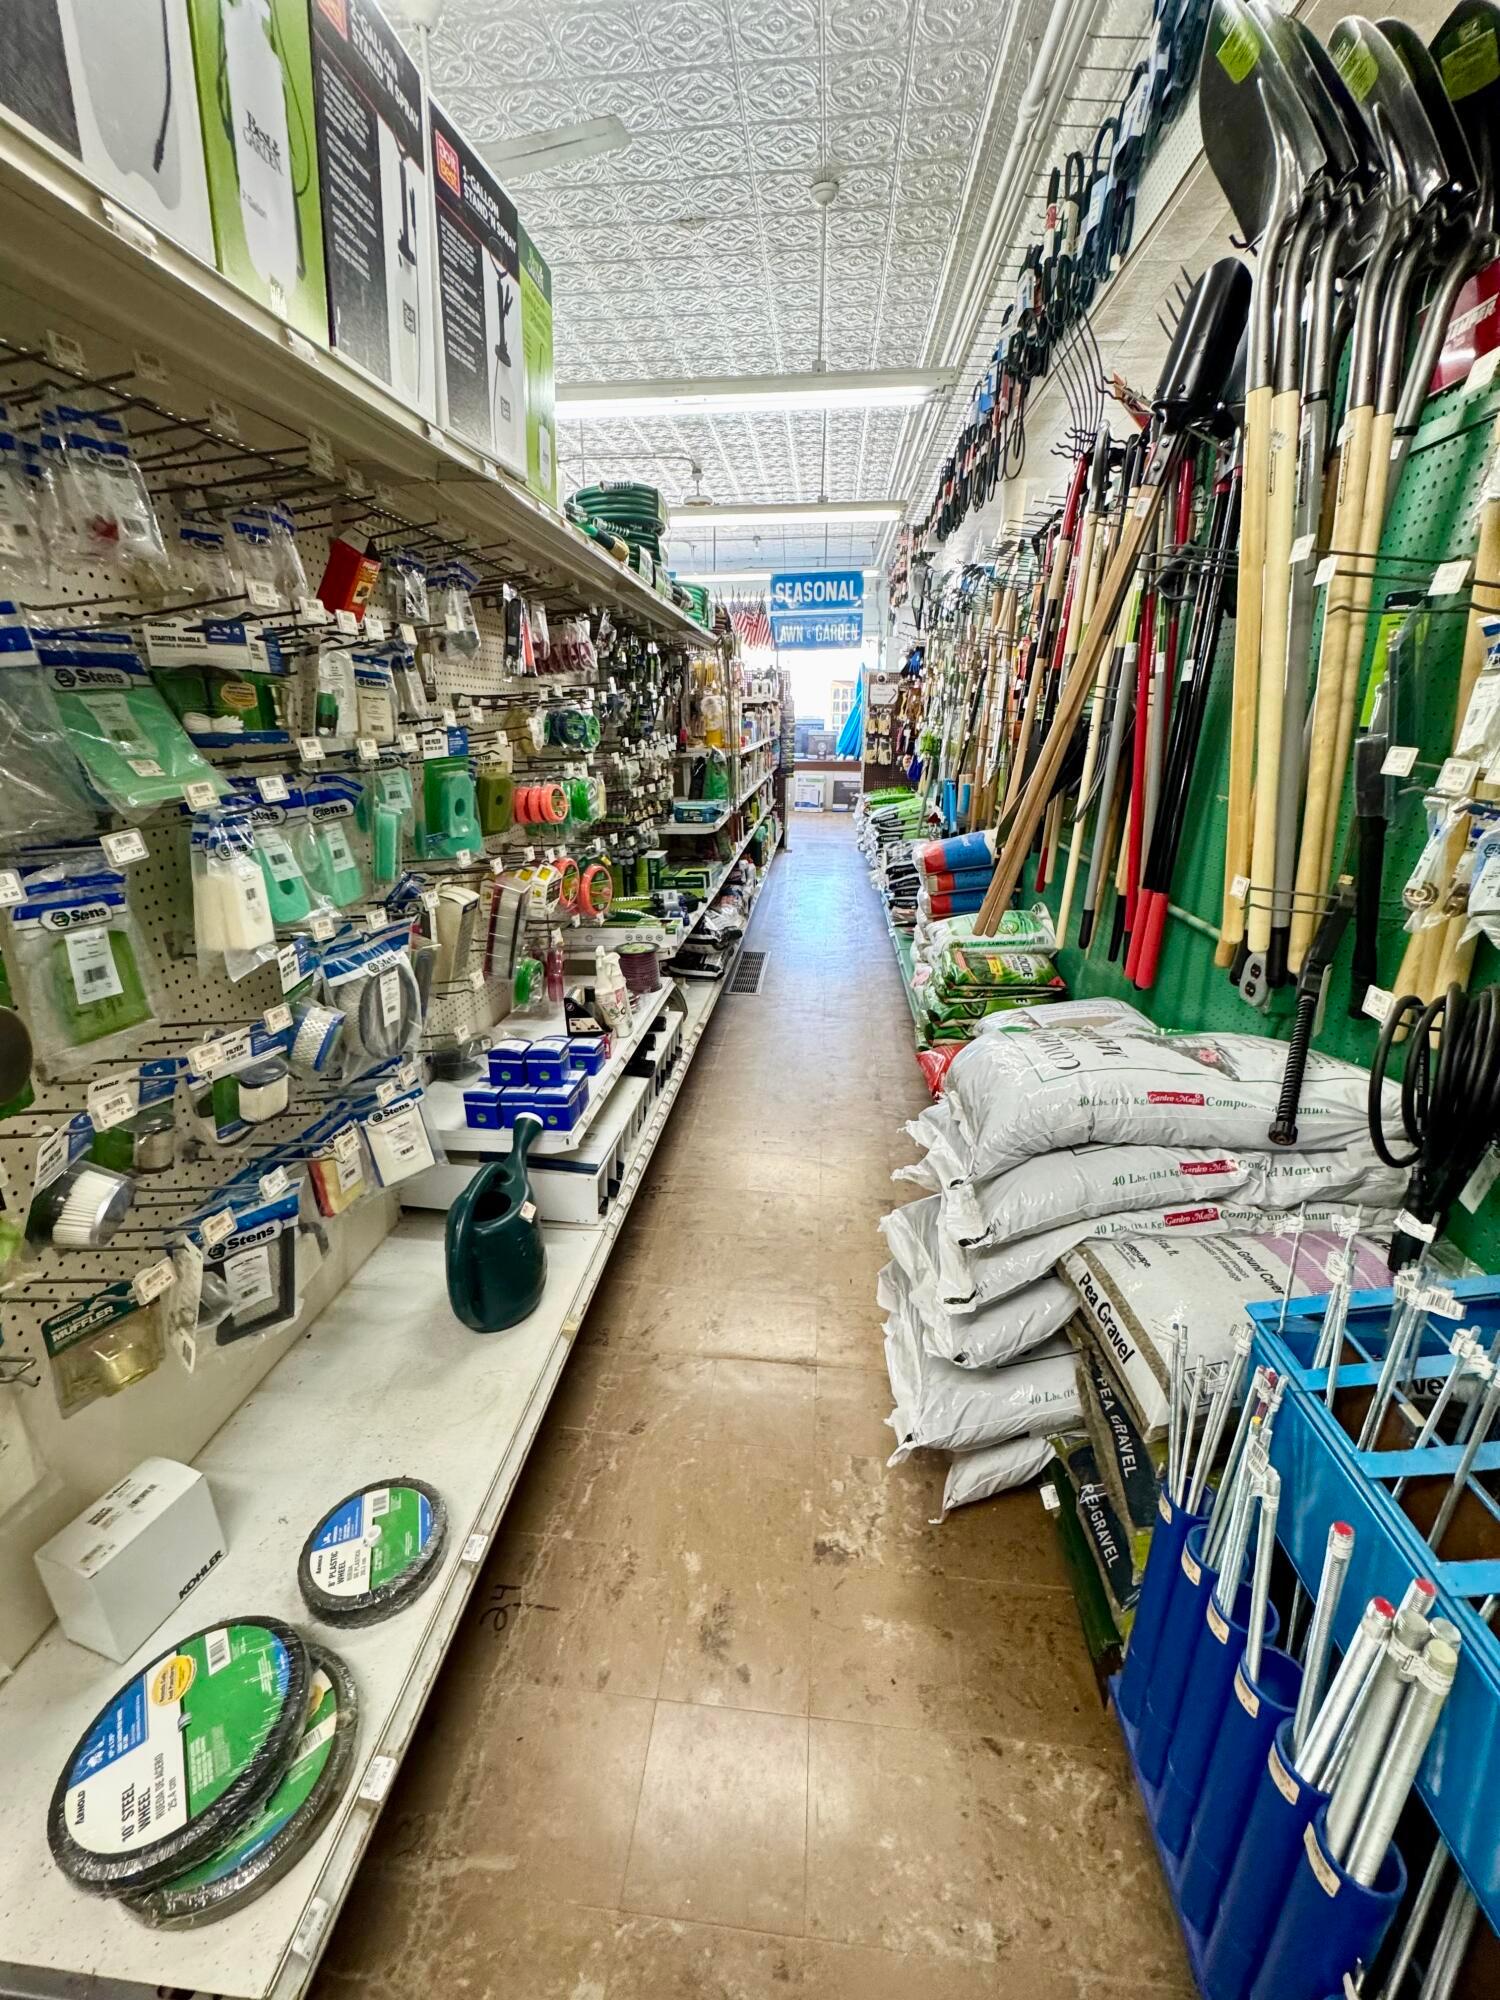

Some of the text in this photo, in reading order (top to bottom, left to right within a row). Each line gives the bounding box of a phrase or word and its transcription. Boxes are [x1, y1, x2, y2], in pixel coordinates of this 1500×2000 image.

[462, 165, 499, 220] 1-GALLON
[463, 182, 488, 221] STAND
[496, 221, 517, 254] SPRAY
[775, 580, 859, 603] SEASONAL
[774, 624, 804, 643] LAWN
[815, 623, 859, 642] GARDEN
[76, 668, 124, 684] Stens
[383, 1102, 410, 1117] Stens
[1077, 1096, 1090, 1107] 40
[1148, 1093, 1175, 1104] Garden
[1112, 1175, 1126, 1187] 40
[1129, 1173, 1149, 1184] Lbs.
[1180, 1164, 1207, 1175] Garden
[1281, 1165, 1332, 1178] Manure
[227, 1225, 275, 1250] Stens
[1094, 1224, 1107, 1236] 40
[1165, 1214, 1191, 1226] Garden
[1191, 1210, 1218, 1222] Magic
[1237, 1250, 1265, 1275] Ground
[1260, 1272, 1285, 1295] Cover
[52, 1305, 114, 1343] MUFFLER
[1078, 1271, 1099, 1307] Pea
[1096, 1302, 1136, 1365] Gravel
[1096, 1376, 1138, 1479] PEA GRAVEL
[1091, 1510, 1120, 1569] GRAVEL
[178, 1550, 223, 1600] KOHLER
[328, 1550, 339, 1580] PLASTIC
[337, 1560, 346, 1585] WHEEL
[121, 1782, 136, 1823] STEEL
[154, 1752, 165, 1821] RUEDA DE ACERO
[75, 1789, 86, 1826] ARNOLD
[138, 1787, 152, 1834] WHEEL
